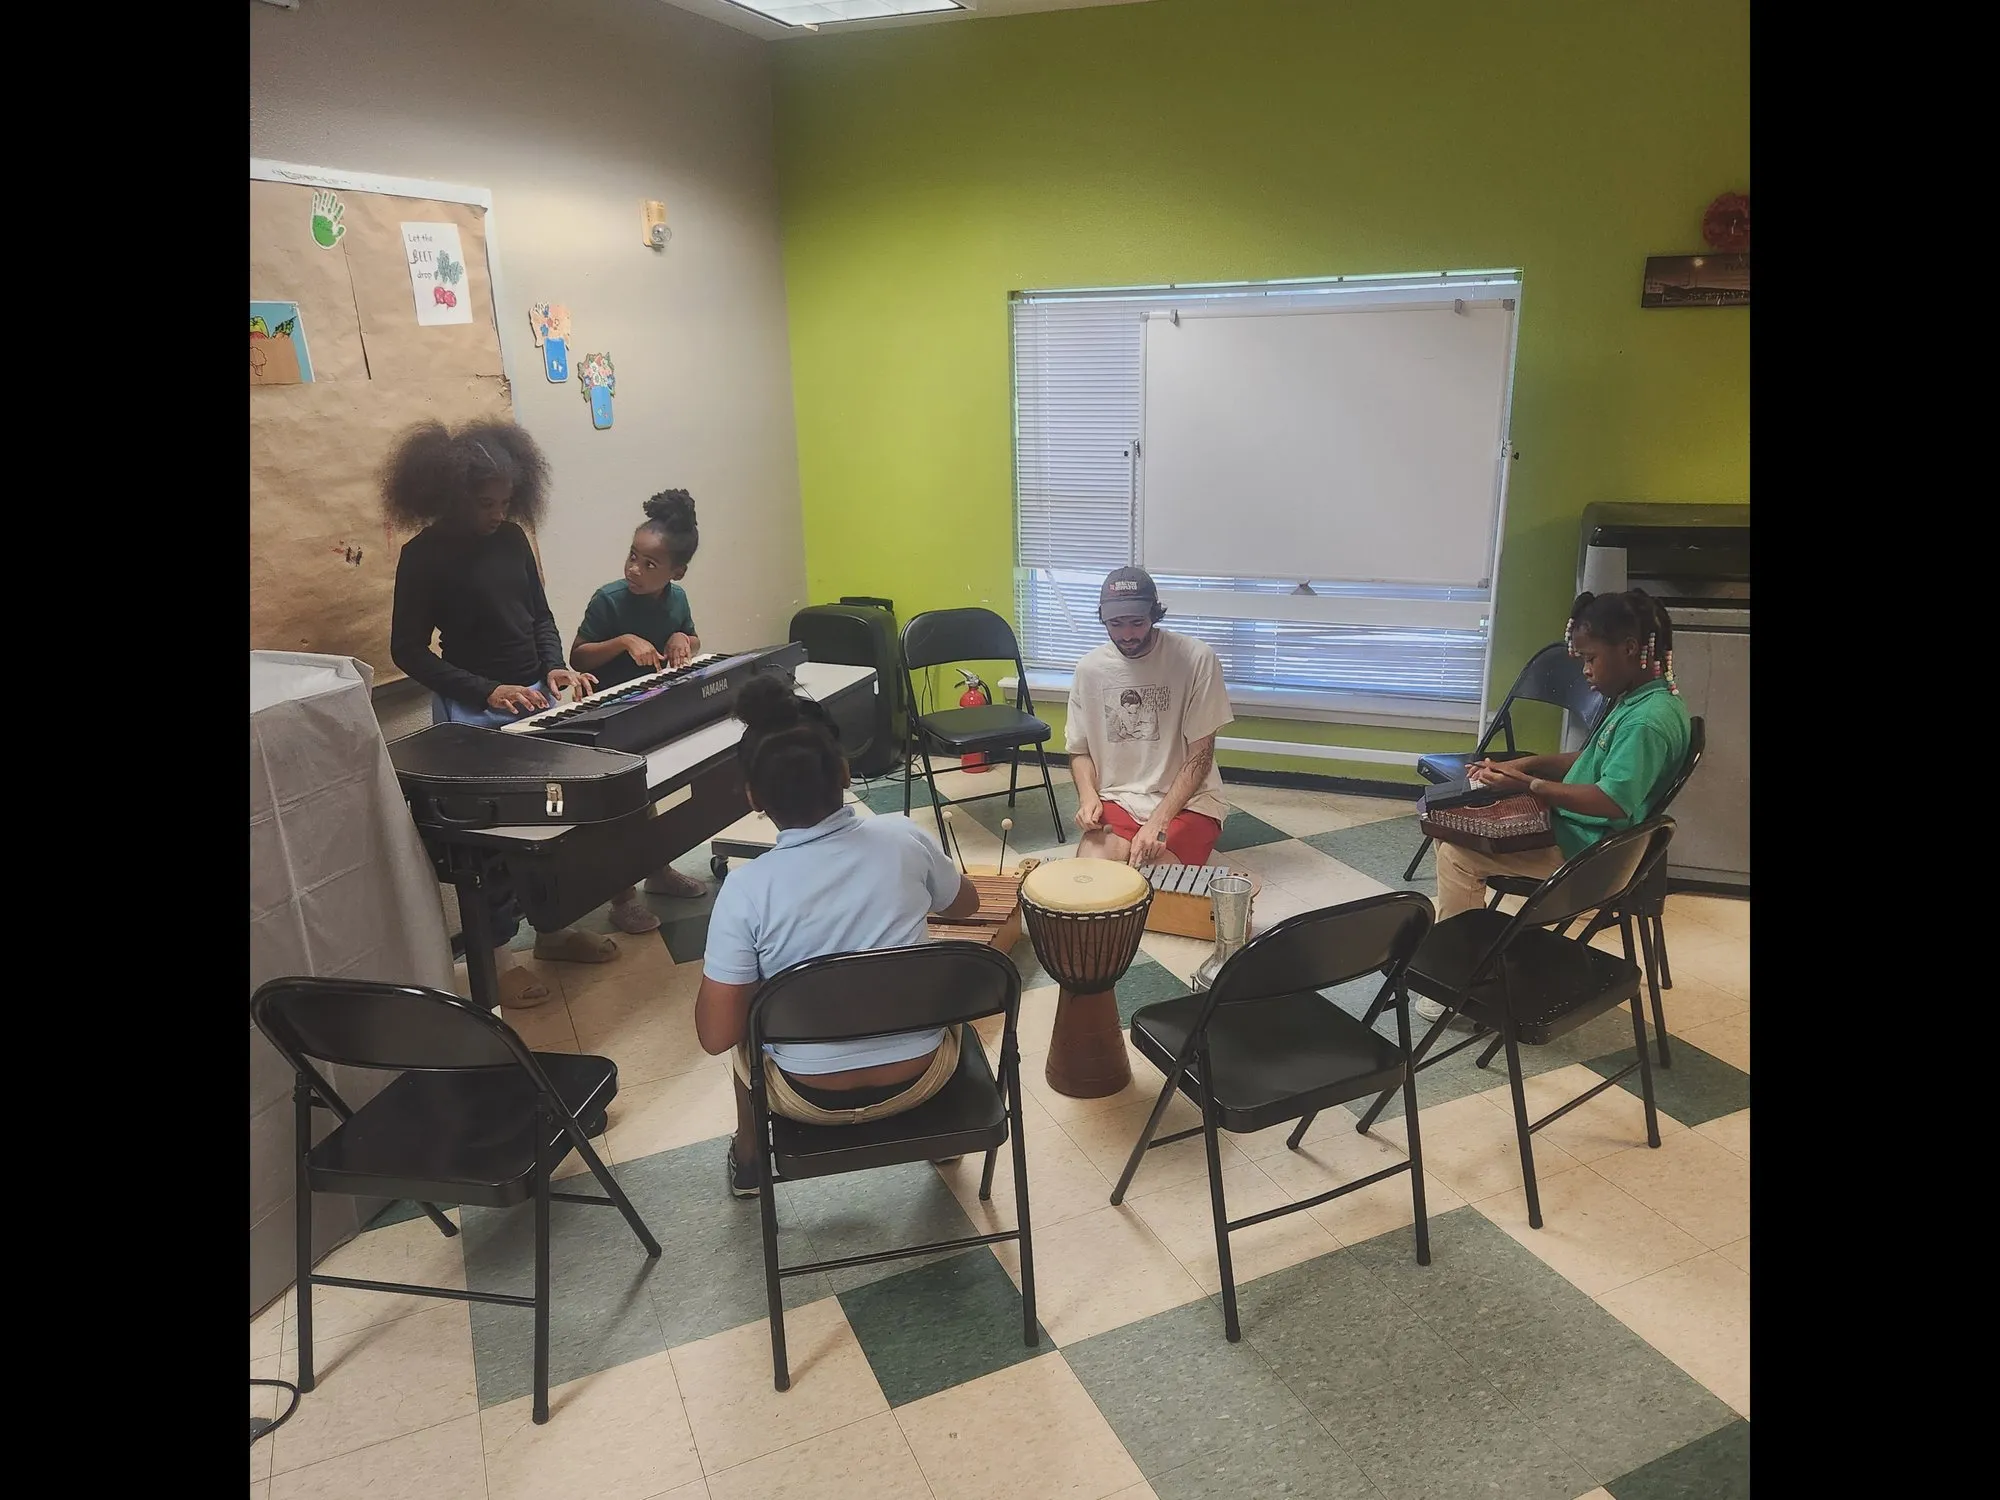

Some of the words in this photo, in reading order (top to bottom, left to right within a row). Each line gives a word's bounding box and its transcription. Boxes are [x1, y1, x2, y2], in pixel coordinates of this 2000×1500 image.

[408, 233, 420, 242] Let
[422, 233, 433, 242] the
[409, 249, 433, 264] BEET
[417, 269, 432, 280] drop
[701, 678, 728, 699] YAMAHA
